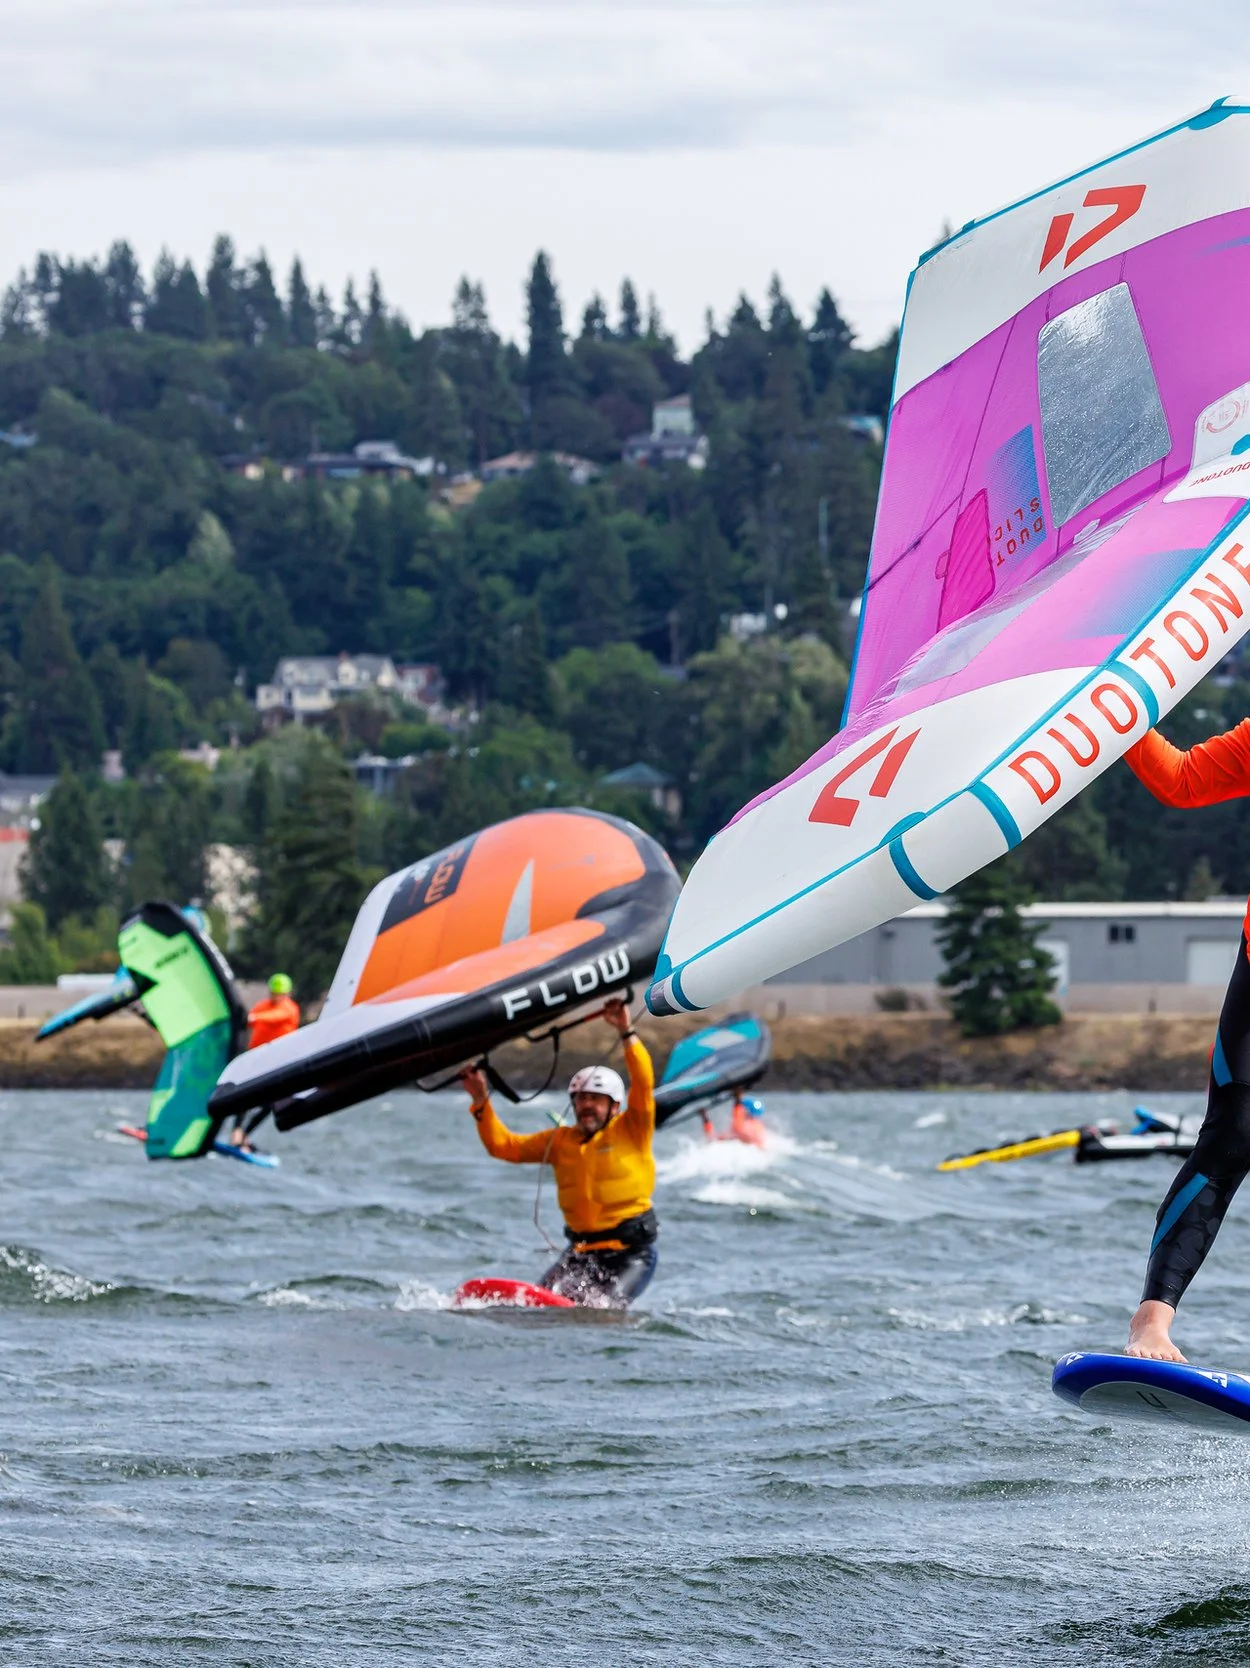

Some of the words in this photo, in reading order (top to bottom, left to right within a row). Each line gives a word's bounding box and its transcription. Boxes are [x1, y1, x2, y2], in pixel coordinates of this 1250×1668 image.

[993, 496, 1040, 542] SLIC
[996, 516, 1043, 567] DUOT
[502, 944, 630, 1020] FLOW
